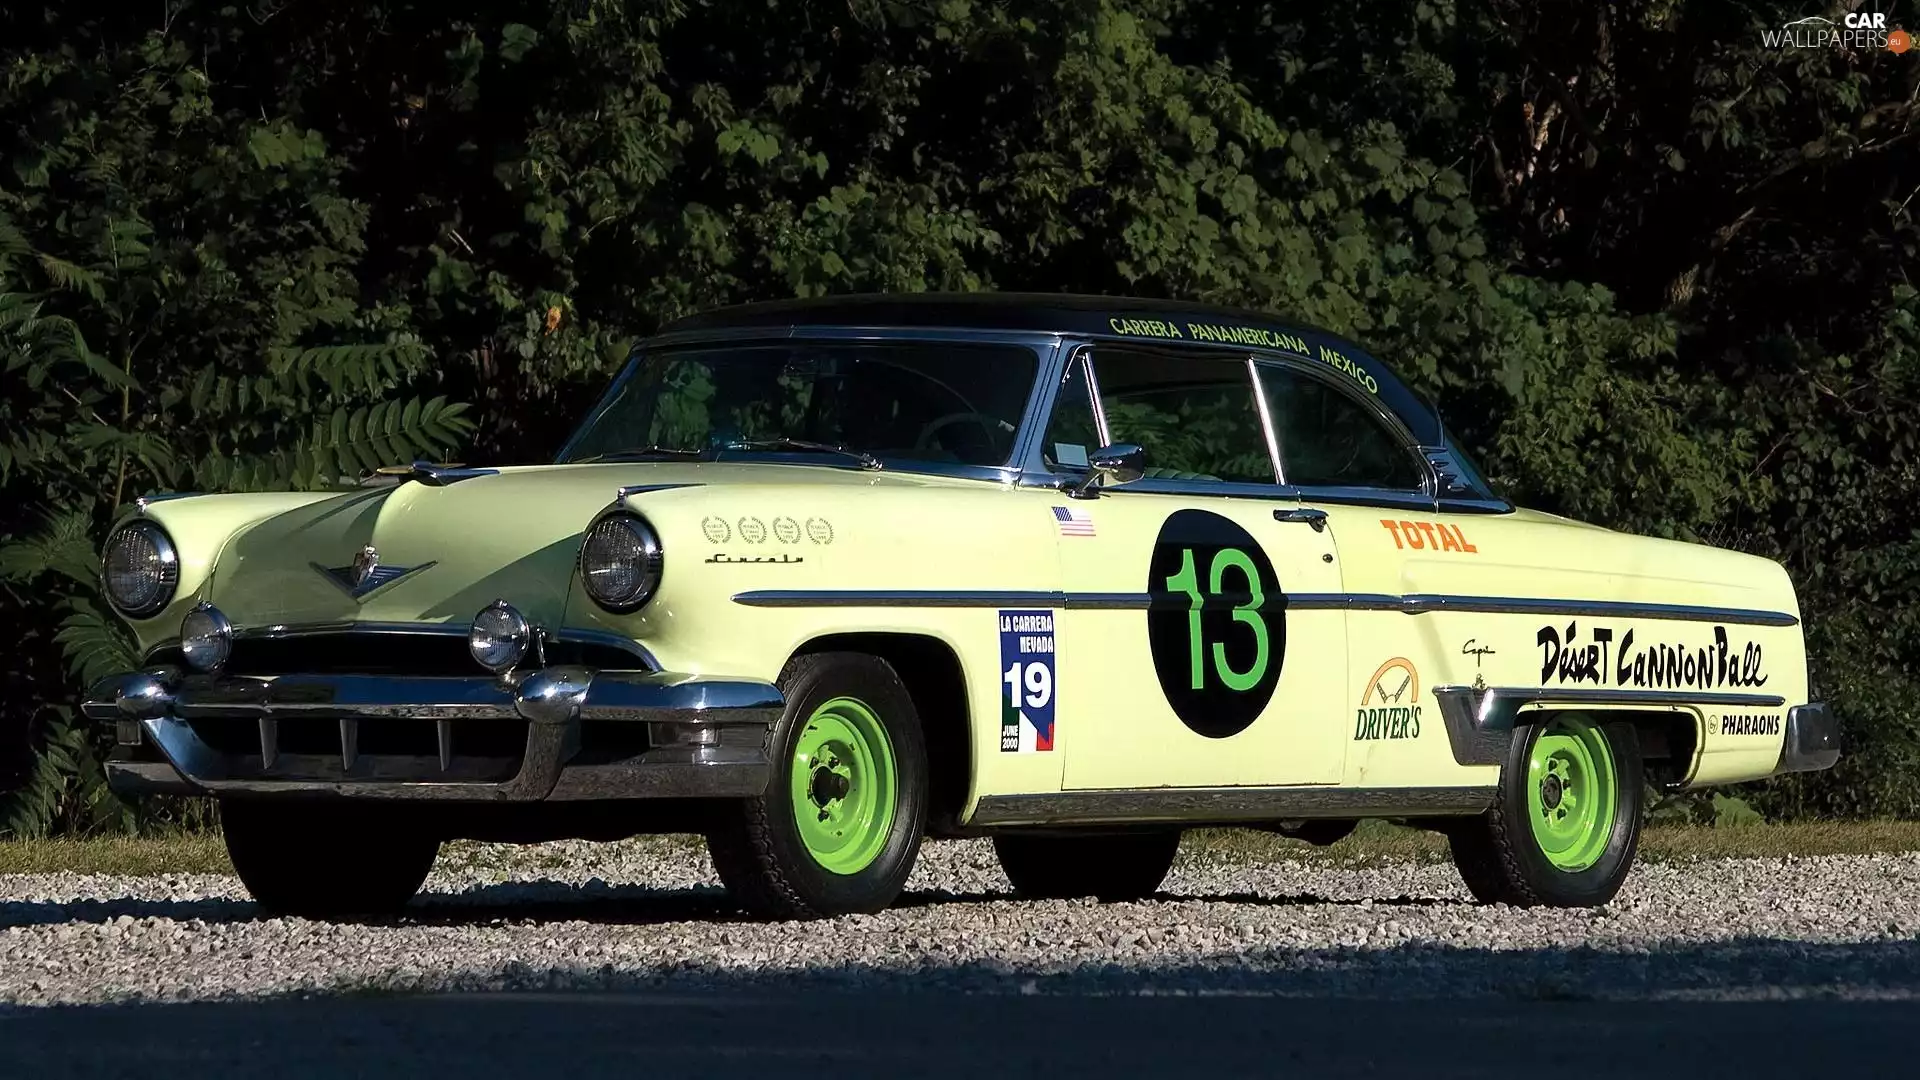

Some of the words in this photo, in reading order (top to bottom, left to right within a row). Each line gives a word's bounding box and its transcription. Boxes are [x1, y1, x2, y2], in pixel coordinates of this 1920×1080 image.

[1110, 318, 1183, 339] CARRERA
[1188, 323, 1310, 355] PANAMERICANA
[1319, 344, 1379, 395] MEXICO
[1380, 519, 1478, 553] TOTAL
[1000, 615, 1012, 633] LA
[1012, 615, 1053, 633] CARRERA
[1166, 548, 1269, 691] 13
[1019, 636, 1054, 654] NEVADA
[1004, 661, 1052, 708] 19
[1002, 725, 1019, 737] JUNE
[1354, 704, 1422, 741] DRIVER'S
[1721, 715, 1780, 735] PHARAONS
[1002, 737, 1018, 750] 2000
